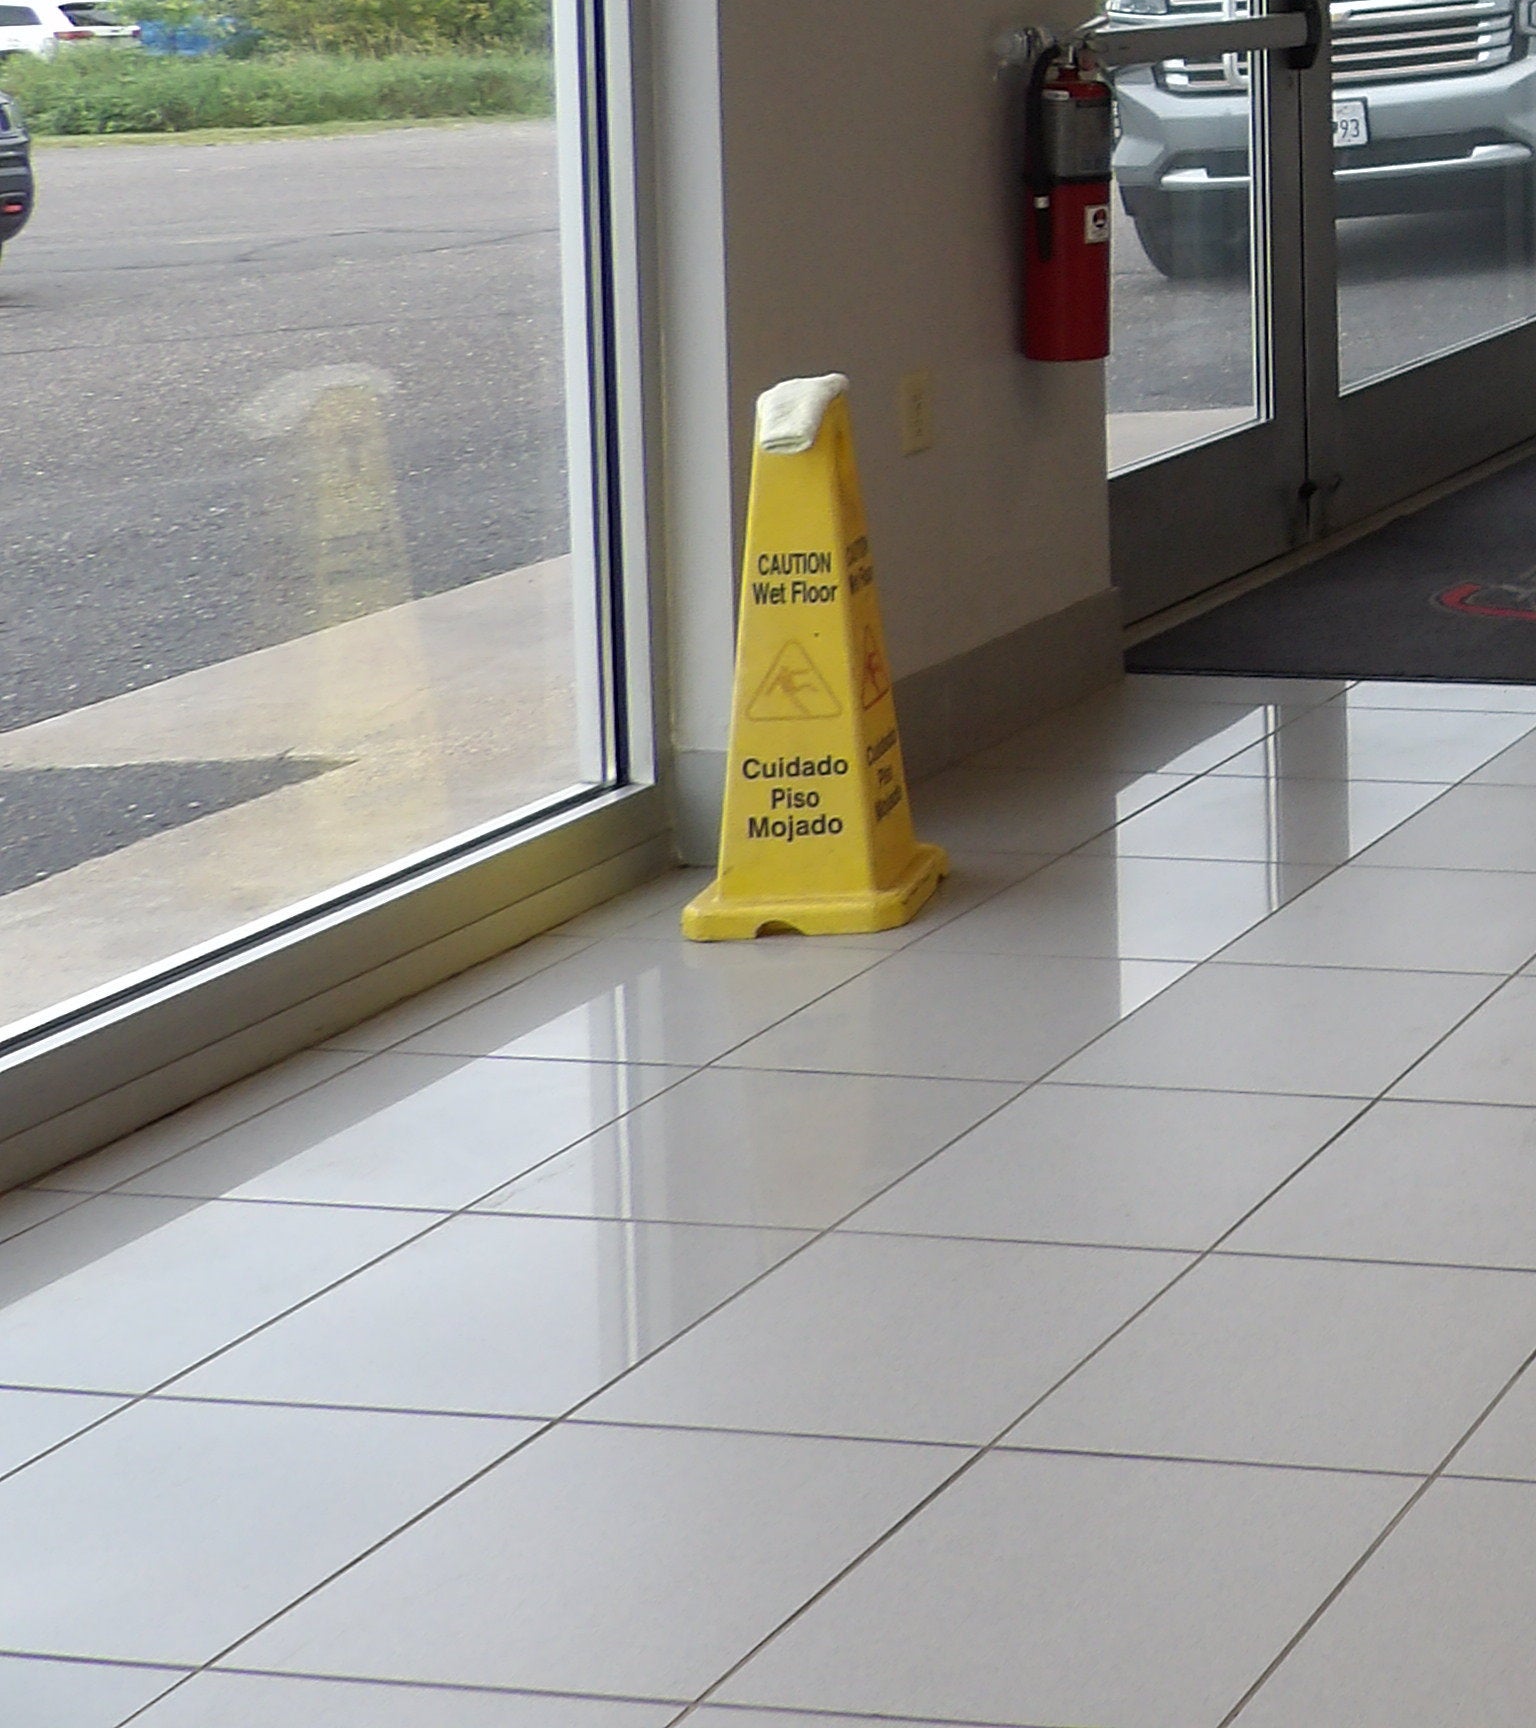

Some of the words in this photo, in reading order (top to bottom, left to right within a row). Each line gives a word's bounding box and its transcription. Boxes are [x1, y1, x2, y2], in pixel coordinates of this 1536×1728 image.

[757, 552, 832, 575] CAUTION
[752, 582, 787, 605] Wet
[791, 580, 838, 604] Floor
[742, 755, 848, 780] Cuidado
[771, 787, 820, 810] Piso
[747, 814, 843, 842] Mojado
